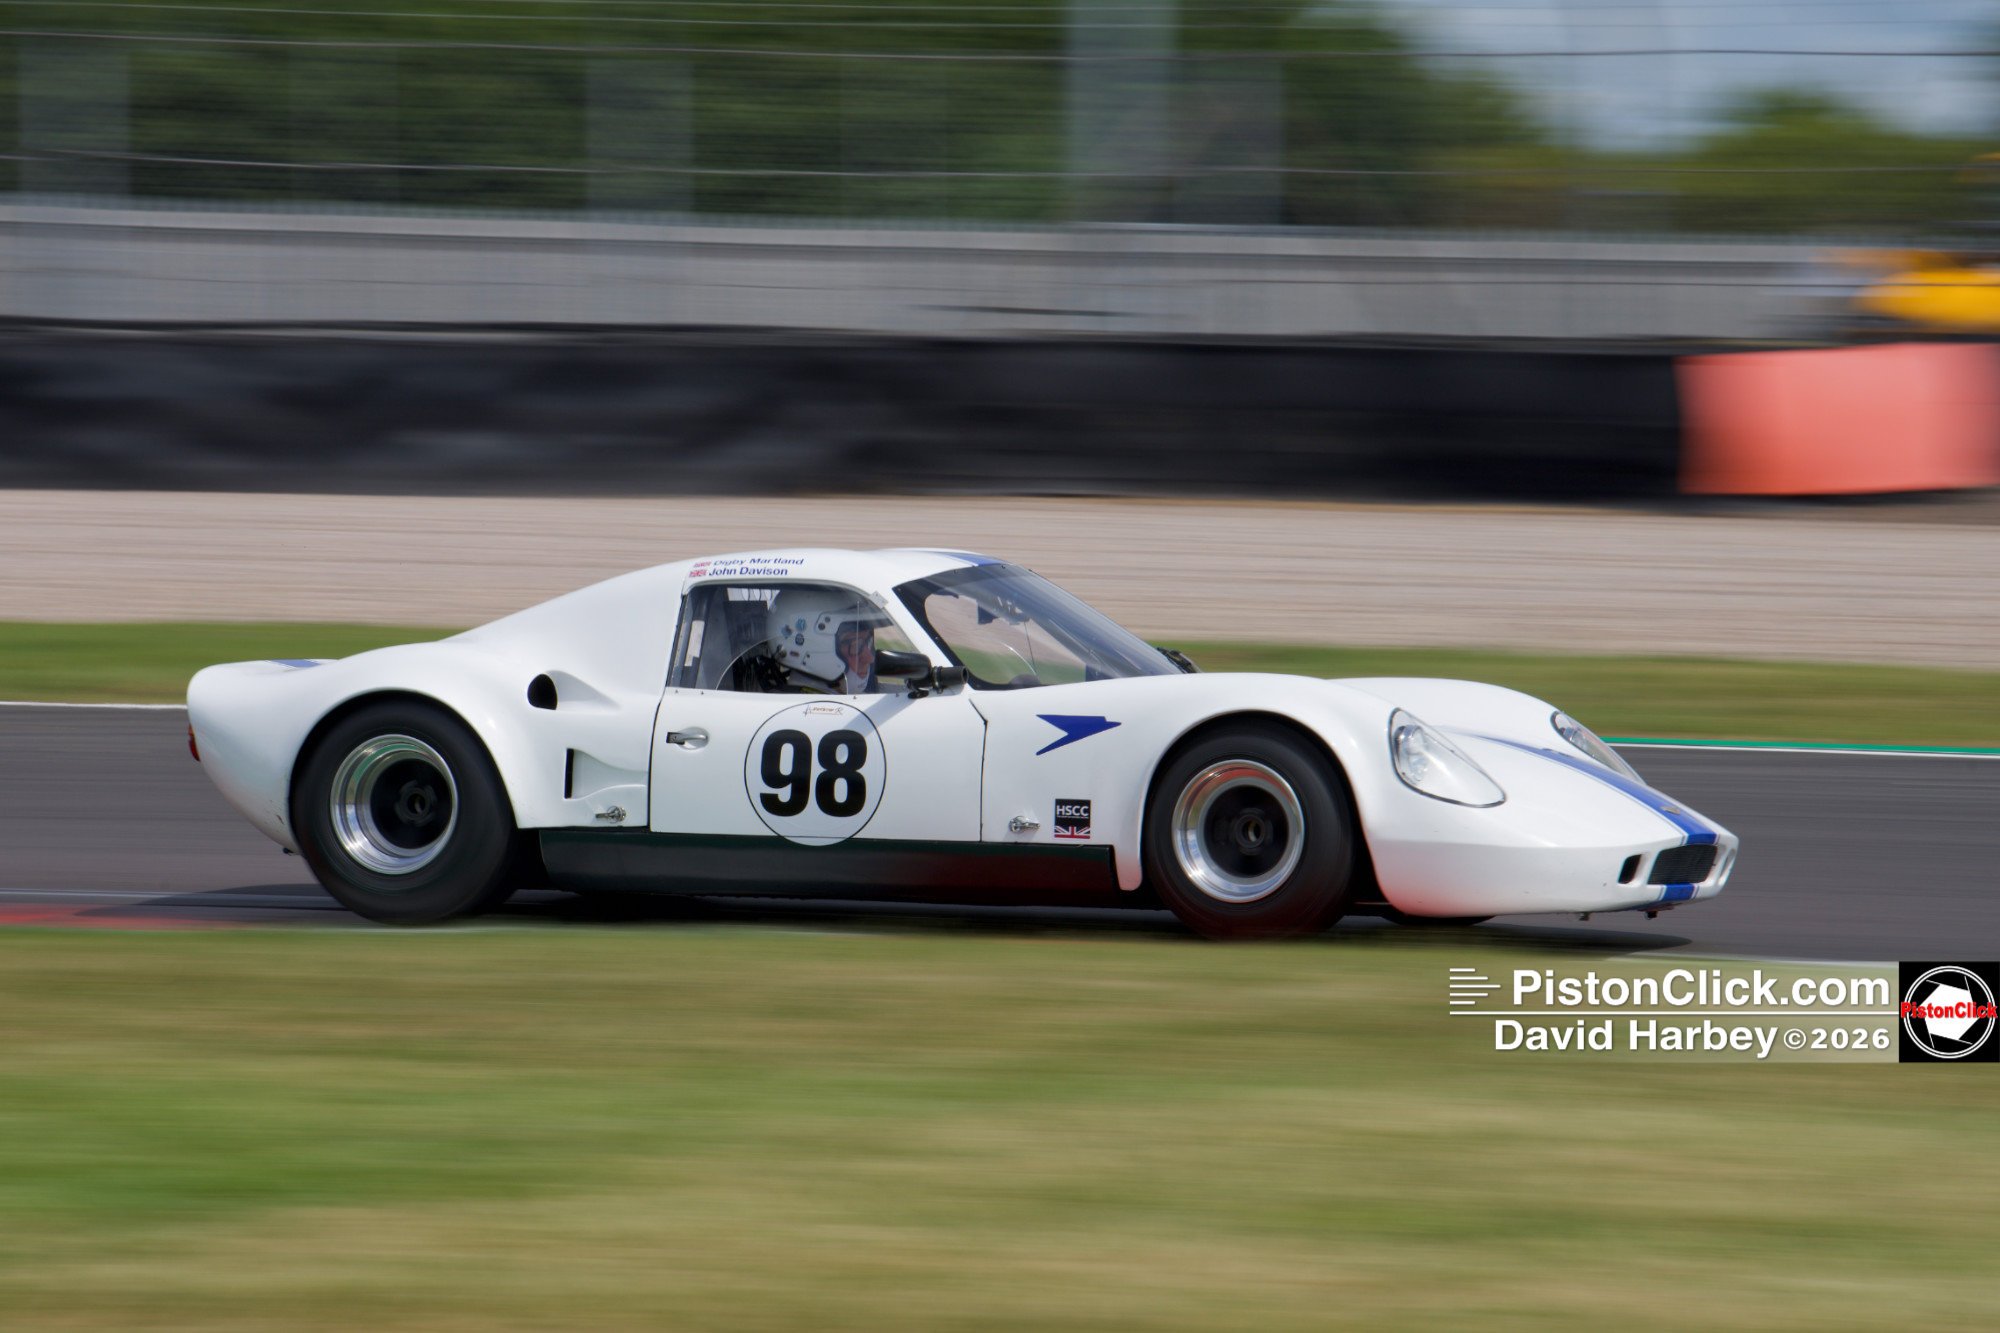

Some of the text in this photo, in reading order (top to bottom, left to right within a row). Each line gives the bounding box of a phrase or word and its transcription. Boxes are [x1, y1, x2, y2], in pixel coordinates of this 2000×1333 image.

[749, 557, 804, 565] Martland
[709, 566, 788, 576] John Davison
[759, 729, 868, 817] 98
[1056, 805, 1089, 817] HSCC
